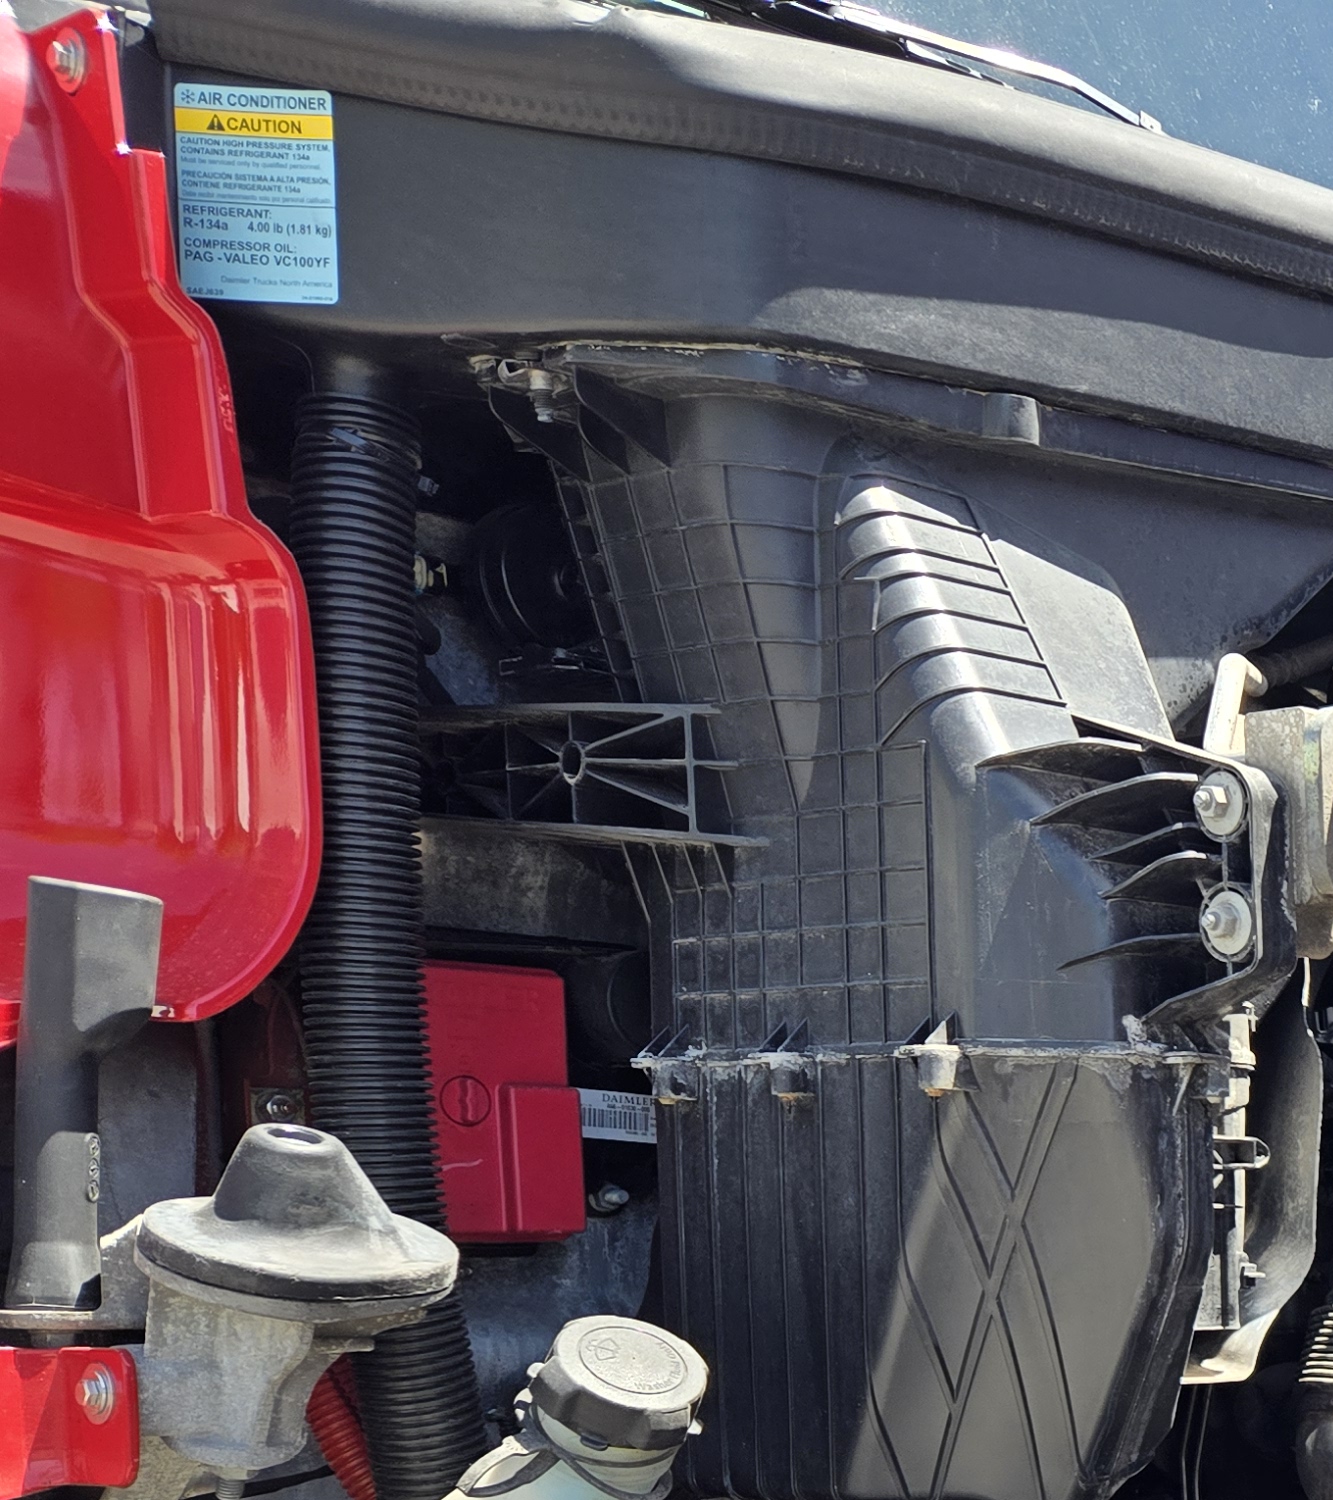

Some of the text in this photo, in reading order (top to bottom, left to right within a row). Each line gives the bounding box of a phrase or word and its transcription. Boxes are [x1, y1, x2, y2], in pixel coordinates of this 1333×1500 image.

[198, 91, 327, 110] AIR CONDITIONER
[227, 117, 302, 134] CAUTION
[180, 136, 221, 147] CAUTION
[222, 140, 244, 148] HIGH
[246, 141, 293, 151] PRESSURE
[180, 146, 310, 161] CONTAINS REFRIGERANT 134a
[237, 160, 250, 168] only
[252, 161, 260, 169] by
[182, 179, 220, 190] CONTIENE
[223, 182, 282, 193] REFRIGERANTE
[235, 173, 268, 182] SISTEMA
[276, 176, 294, 184] ALTA
[183, 204, 272, 220] REFRIGERANT:
[183, 217, 332, 238] R-134a 4.00 lb (1.81 kg)
[184, 236, 298, 254] COMPRESSOR OIL:
[184, 250, 214, 262] PAG
[273, 254, 330, 268] VC100YF
[221, 275, 333, 289] Daimler Trucks North America
